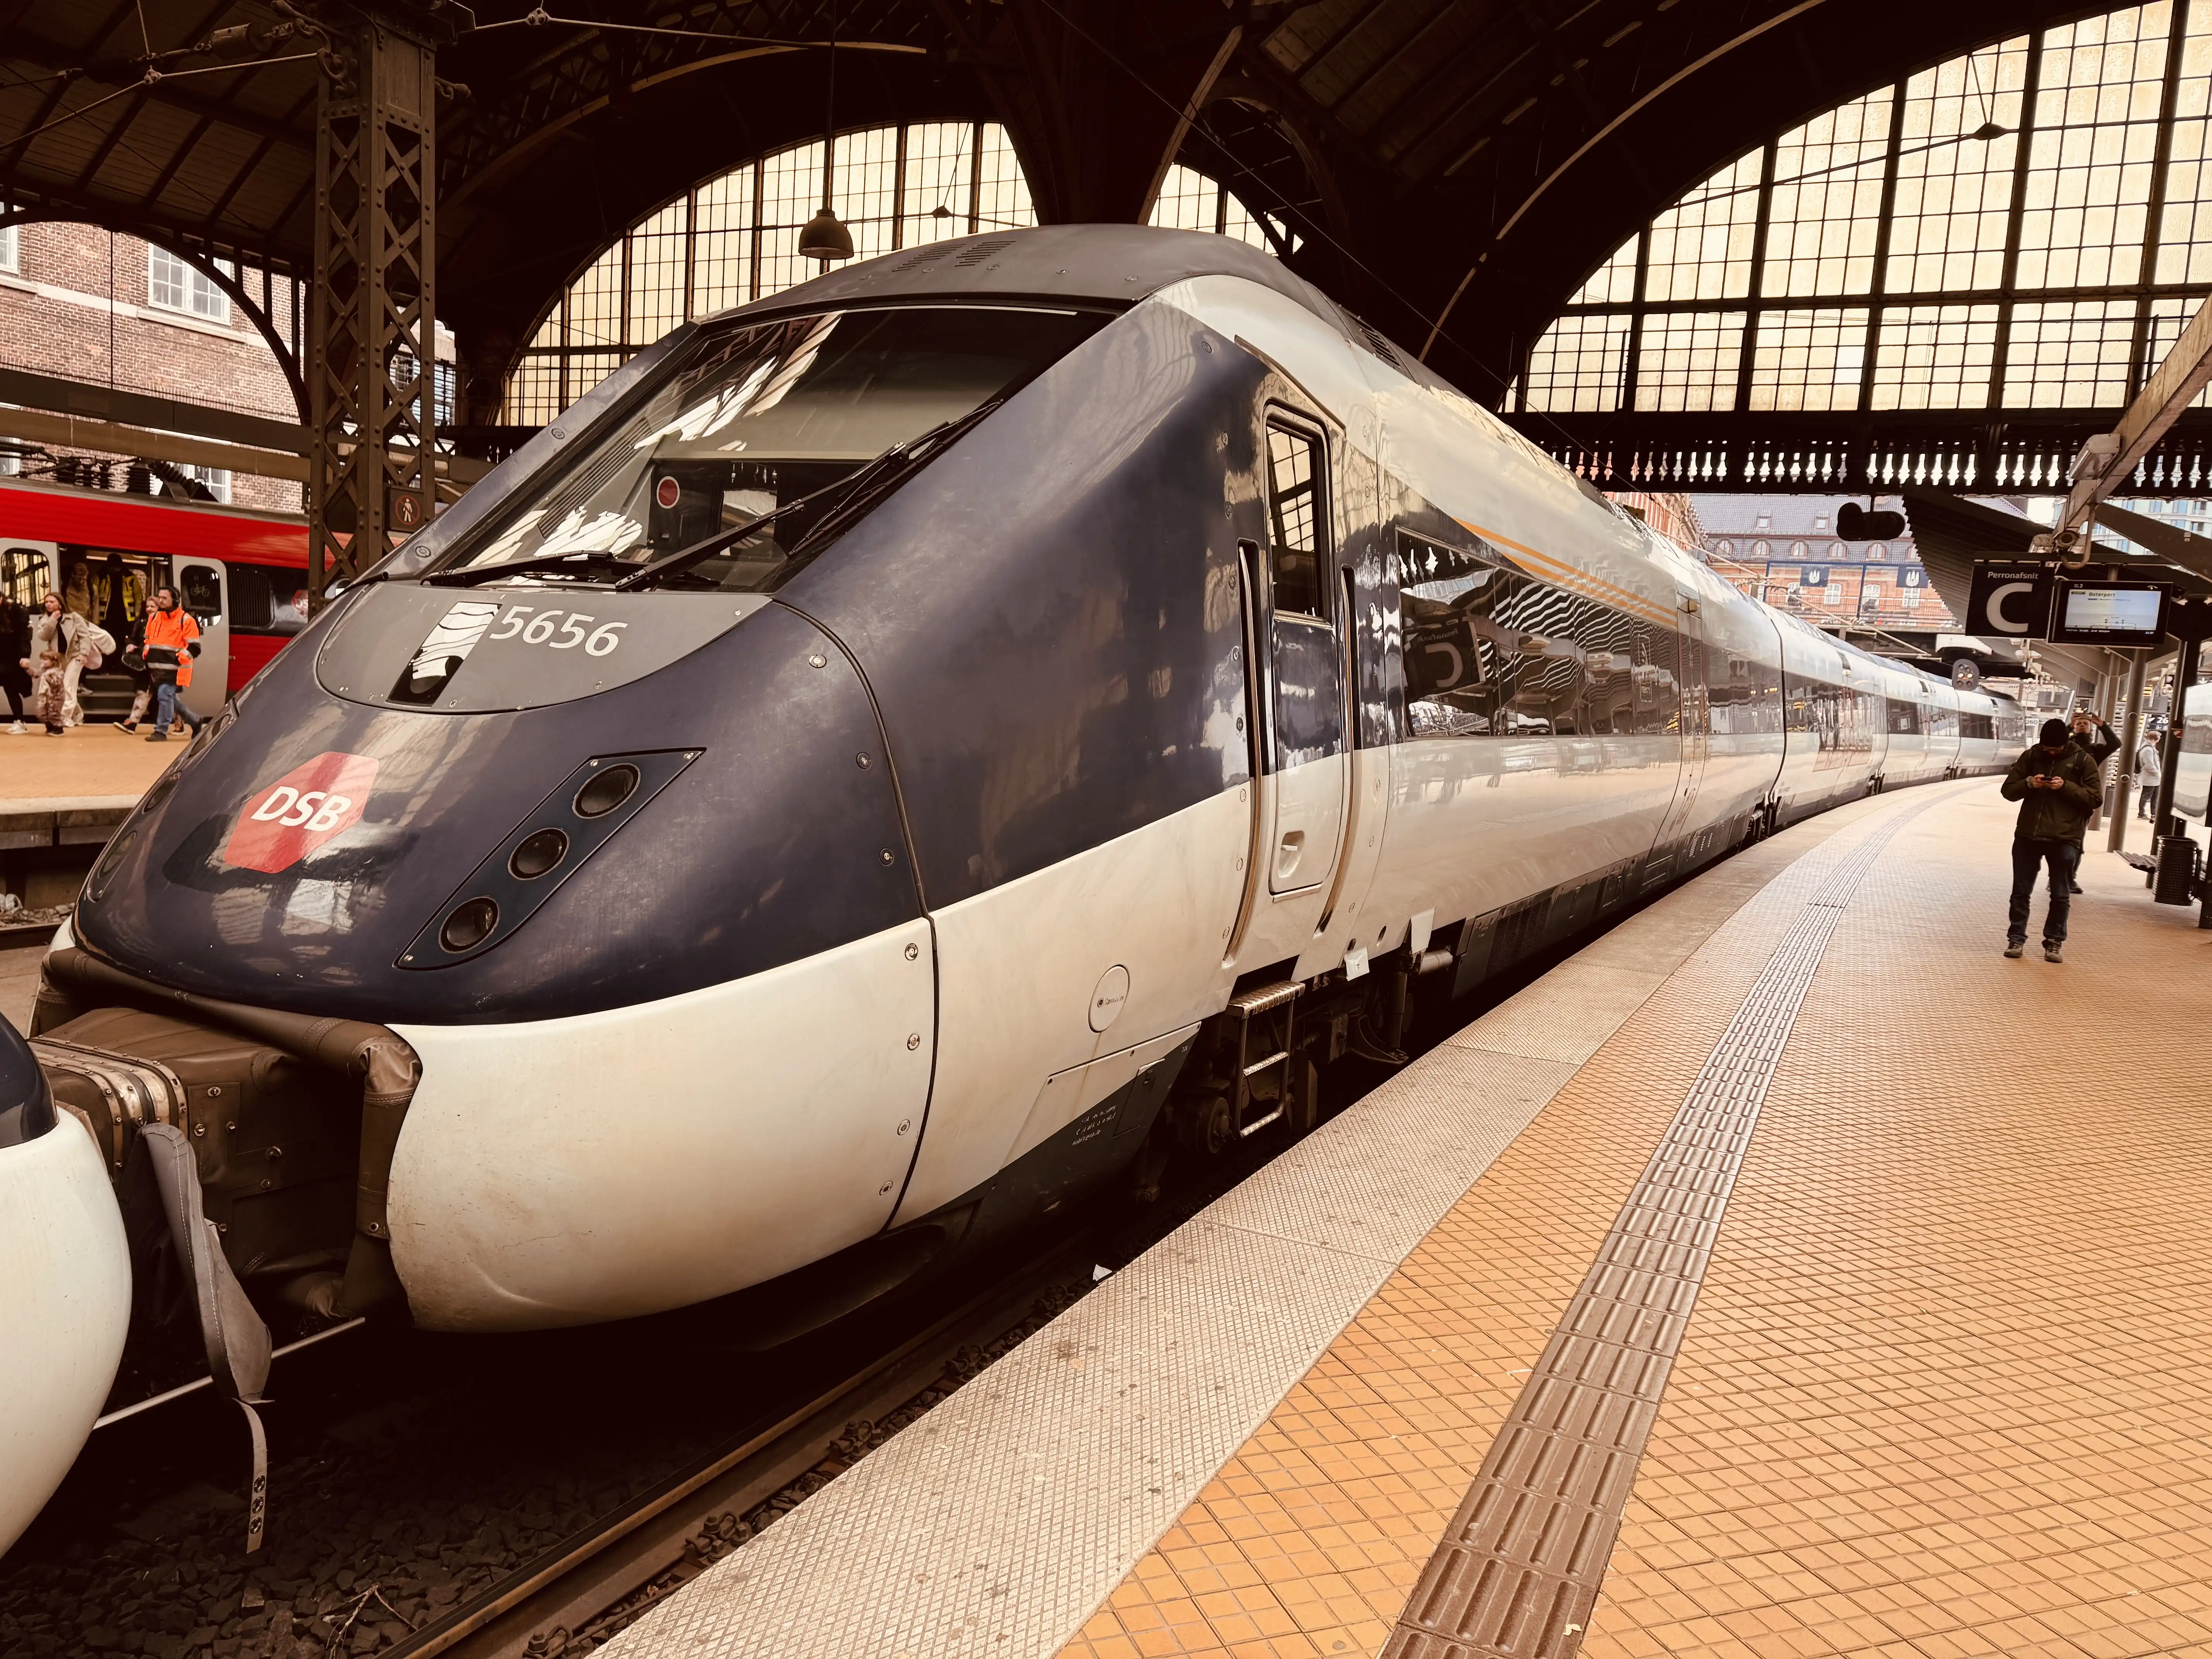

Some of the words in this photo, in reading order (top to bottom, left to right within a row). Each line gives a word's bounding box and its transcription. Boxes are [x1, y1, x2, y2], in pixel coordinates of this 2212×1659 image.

[1987, 571, 2038, 580] Perronafsnit
[295, 598, 308, 609] DS
[1986, 582, 2033, 632] C
[489, 606, 628, 656] 5656
[251, 786, 352, 832] DSB
